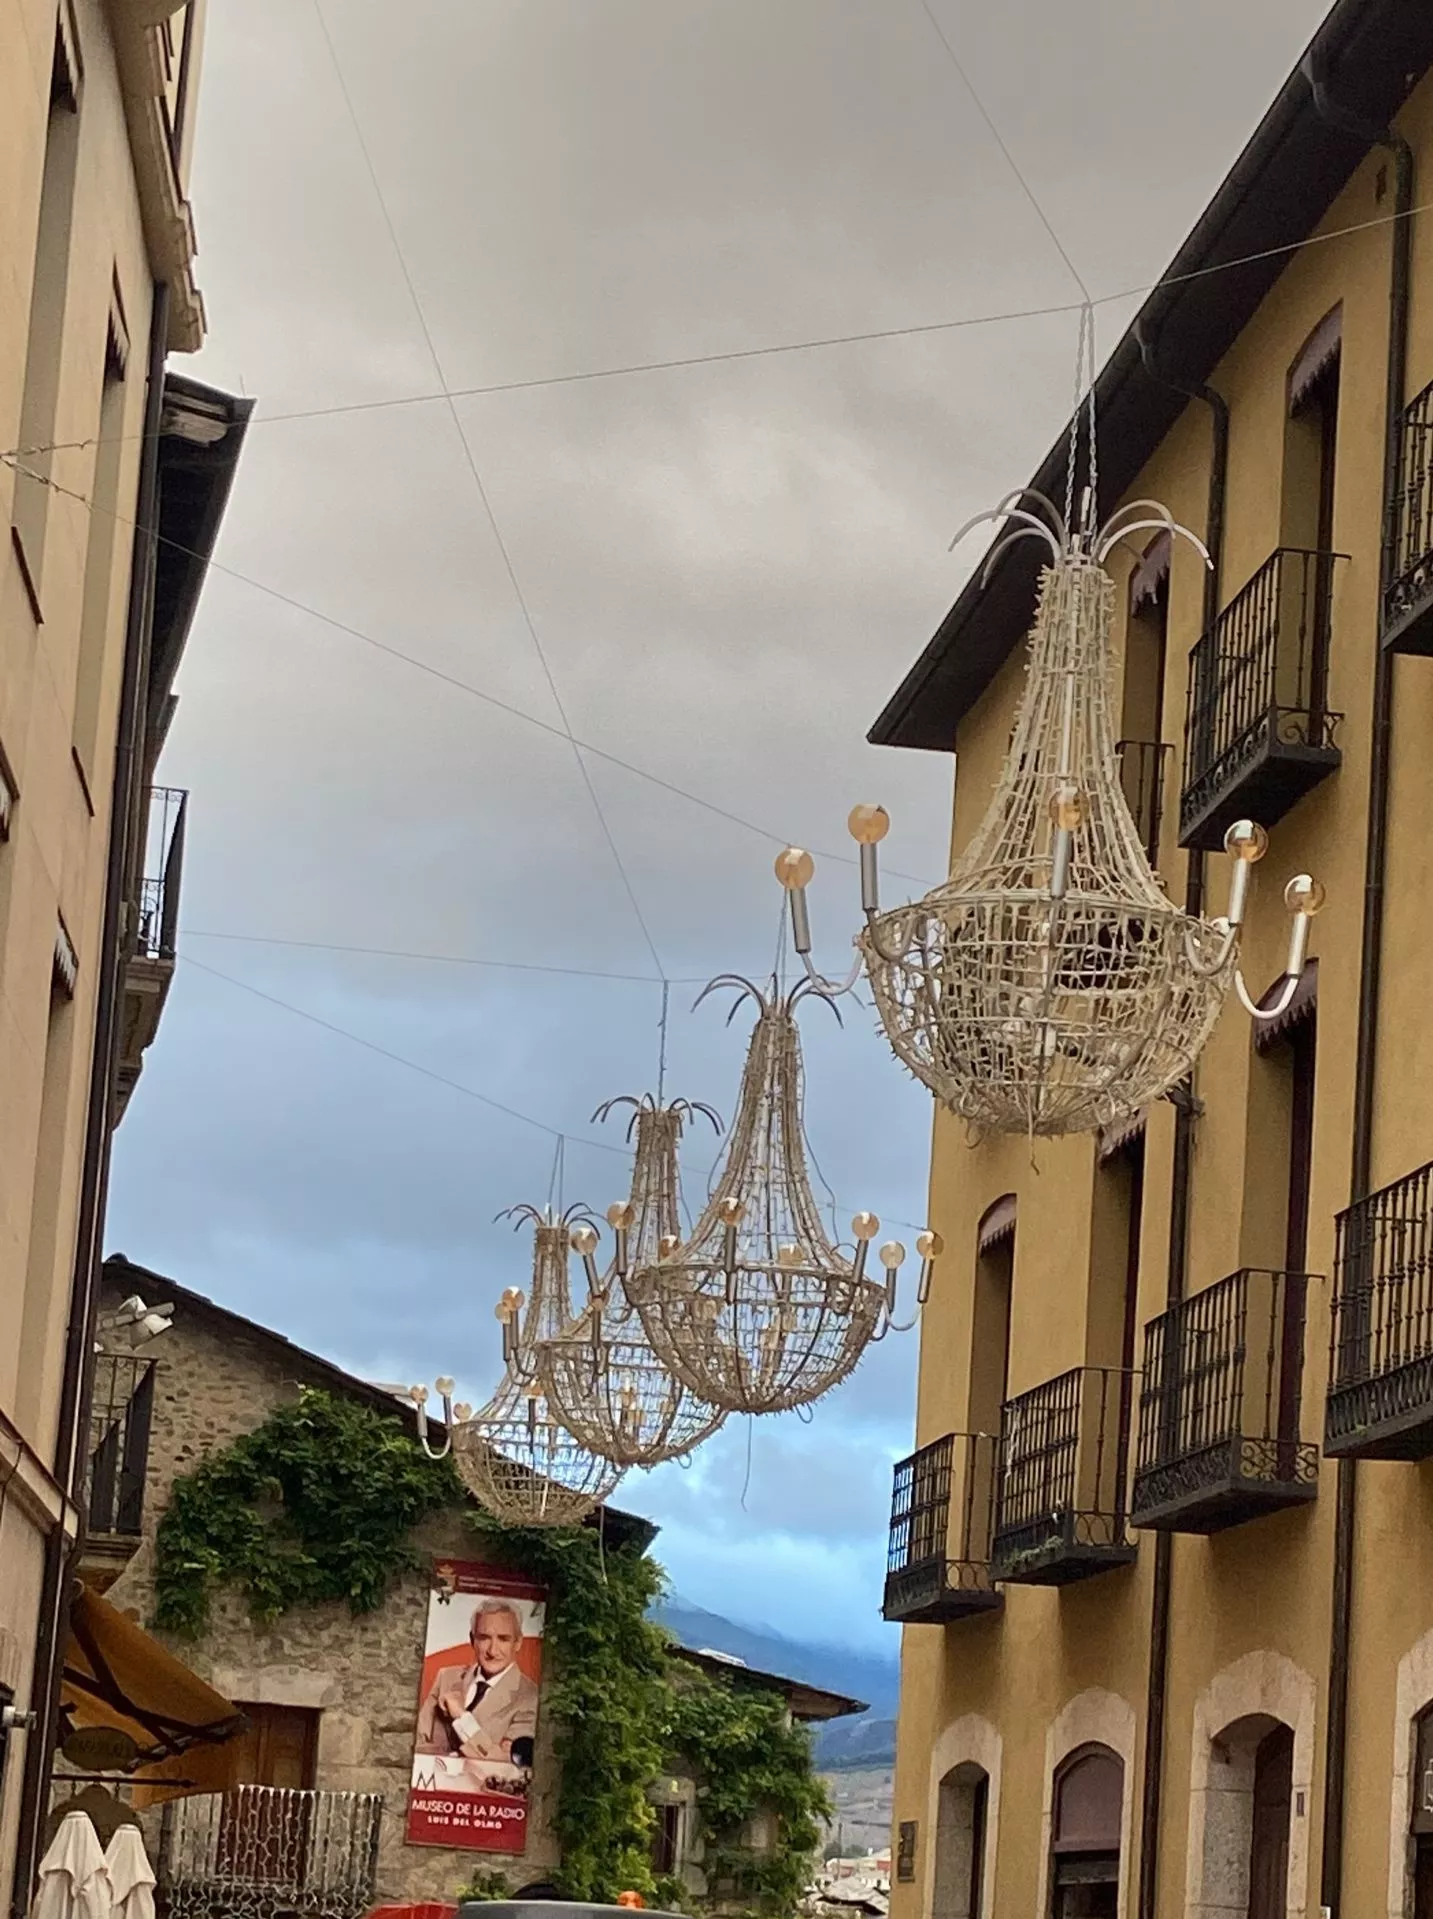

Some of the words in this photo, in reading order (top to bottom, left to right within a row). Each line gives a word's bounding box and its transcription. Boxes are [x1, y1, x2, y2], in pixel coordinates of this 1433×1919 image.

[412, 1800, 454, 1814] MUSEO
[456, 1803, 471, 1815] DE
[473, 1804, 487, 1817] LA
[489, 1805, 526, 1820] RADIO
[427, 1815, 449, 1825] LUIS
[452, 1817, 470, 1826] DEL
[473, 1819, 503, 1829] OLMO
